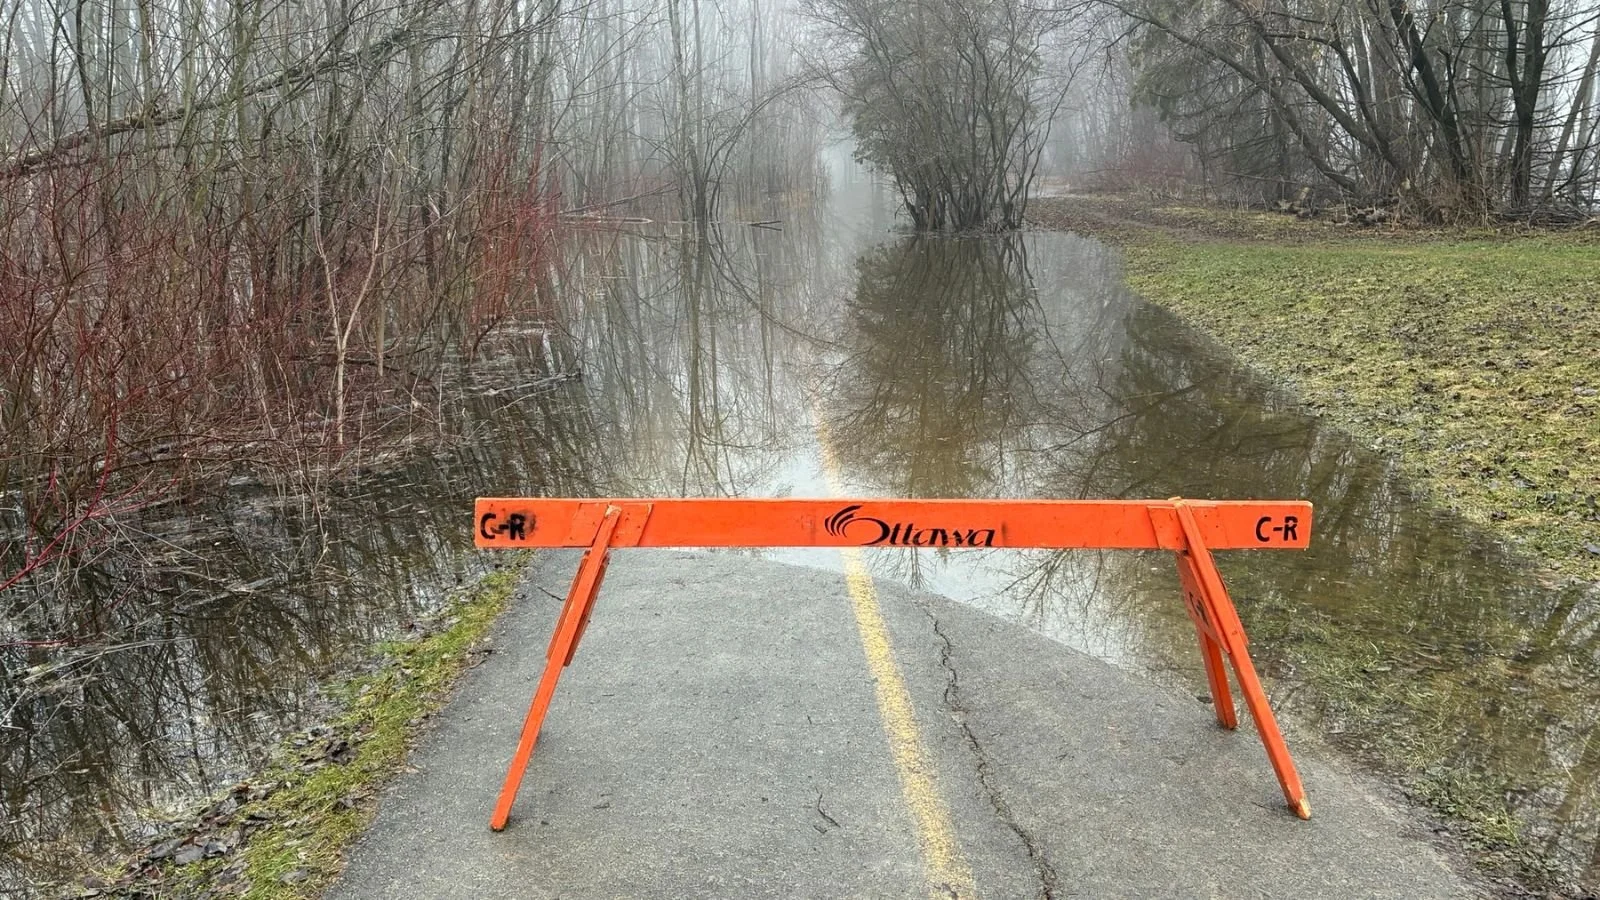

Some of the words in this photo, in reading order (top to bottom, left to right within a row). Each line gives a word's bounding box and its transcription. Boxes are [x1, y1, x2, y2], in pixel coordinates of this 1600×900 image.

[480, 513, 526, 540] C-R
[824, 505, 996, 546] Ottawa
[1255, 516, 1298, 542] C-R
